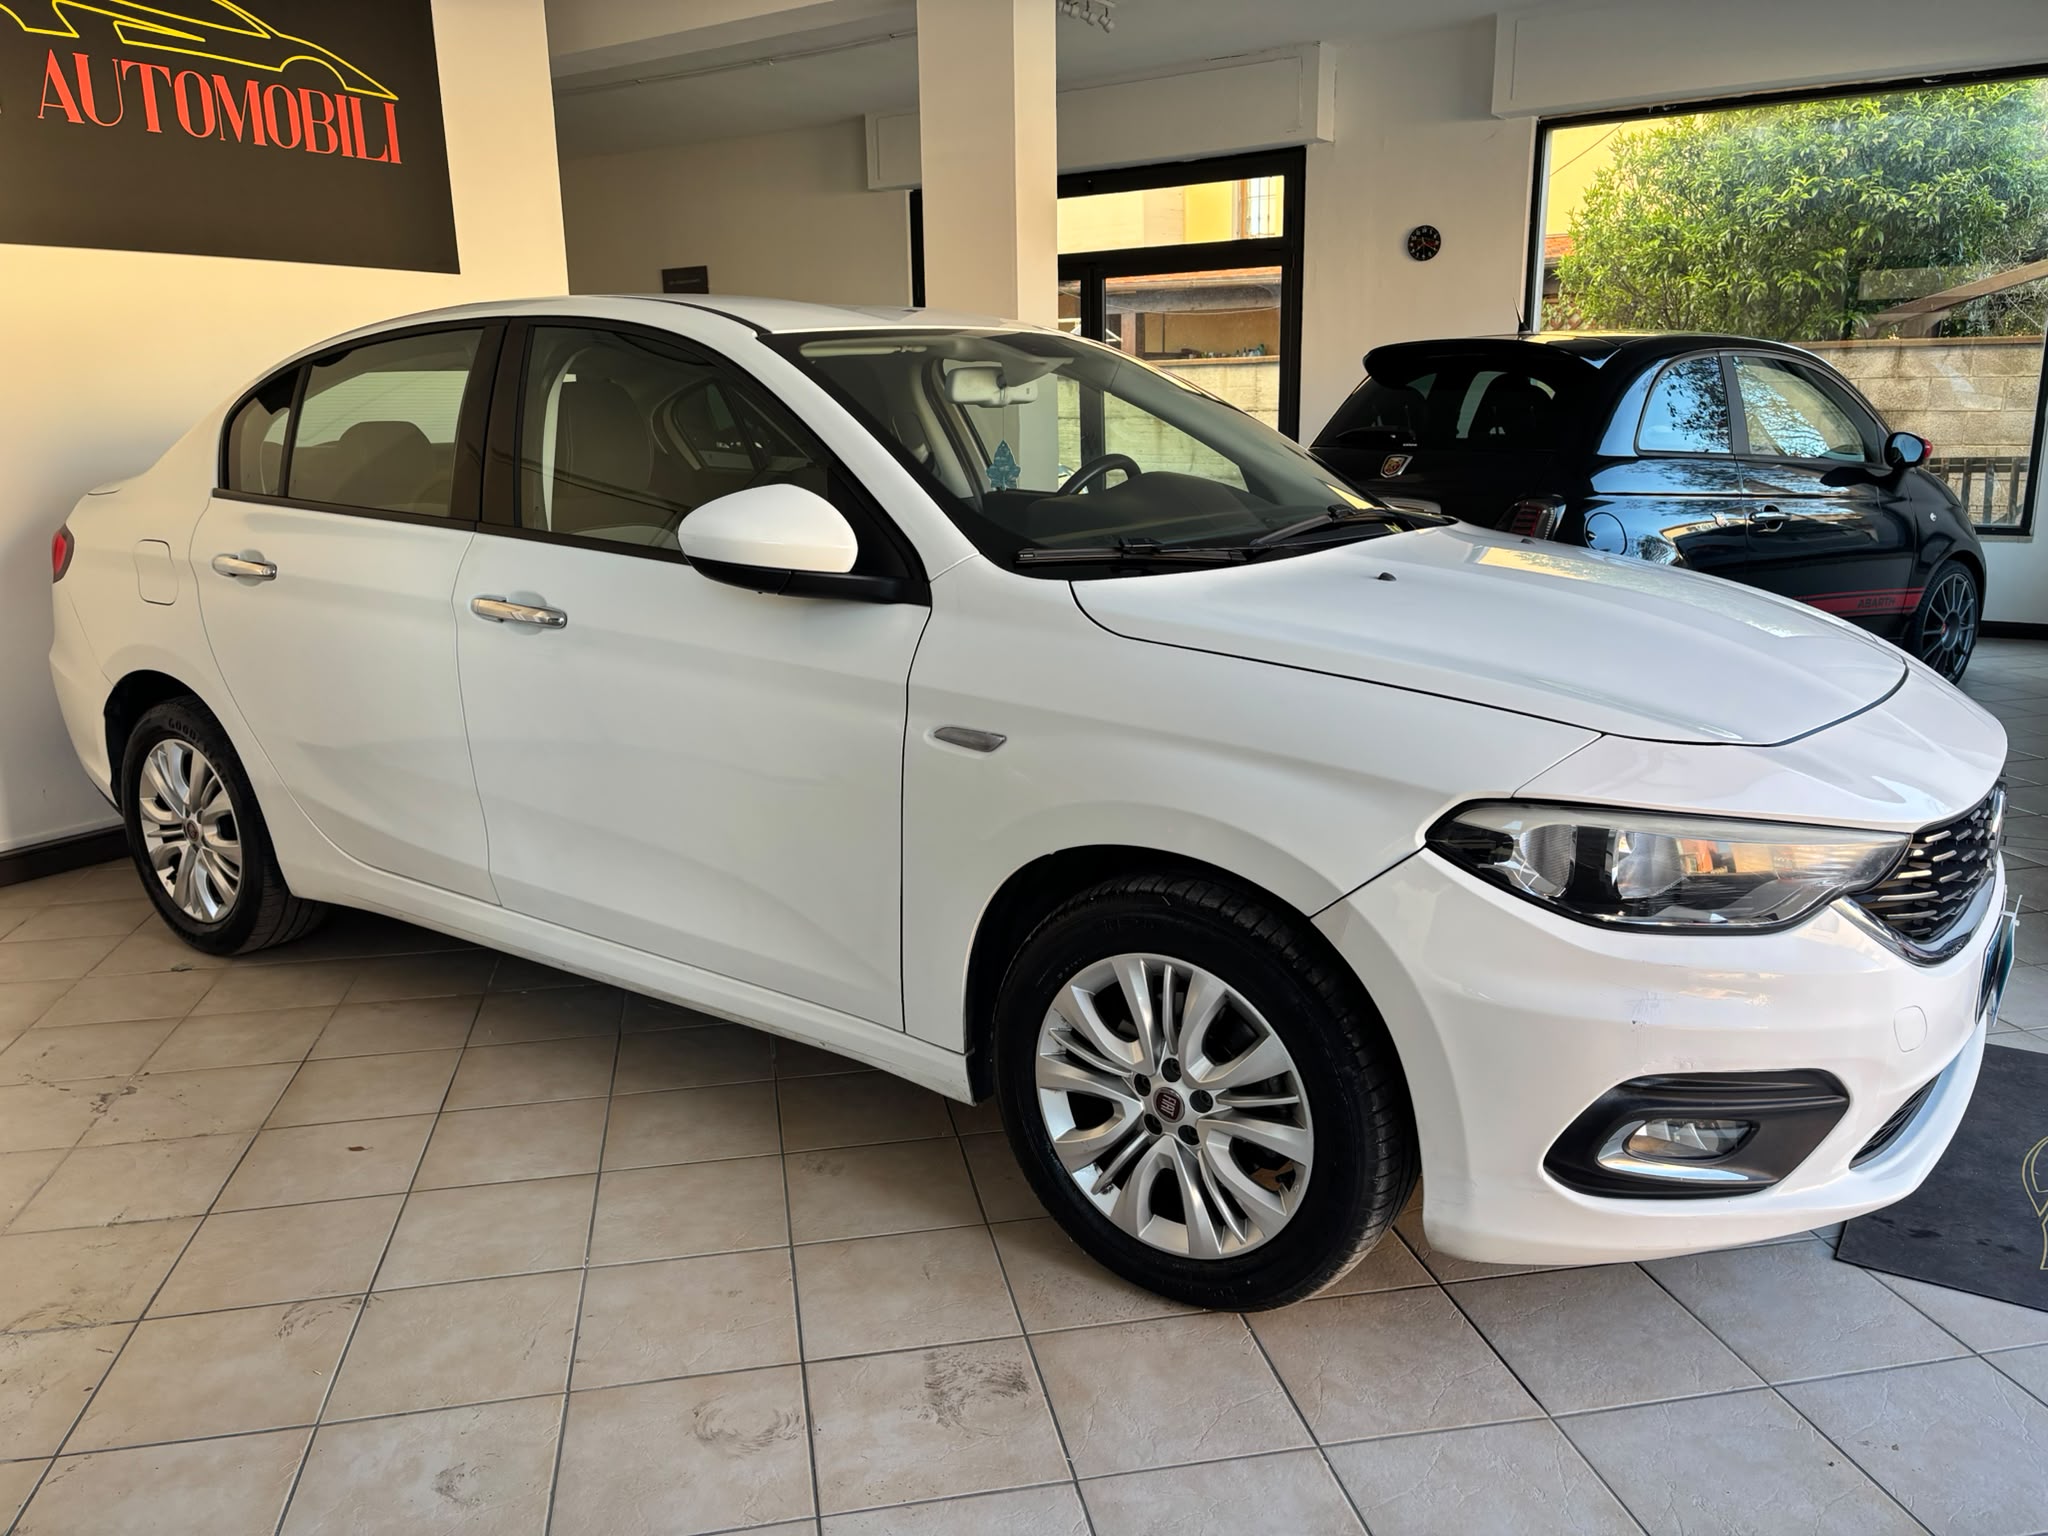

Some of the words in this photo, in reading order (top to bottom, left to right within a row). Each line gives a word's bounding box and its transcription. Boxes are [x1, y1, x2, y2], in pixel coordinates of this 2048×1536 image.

[38, 49, 402, 164] AUTOMOBILI
[1857, 597, 1896, 608] ABARTH
[1160, 1094, 1177, 1117] FIAT
